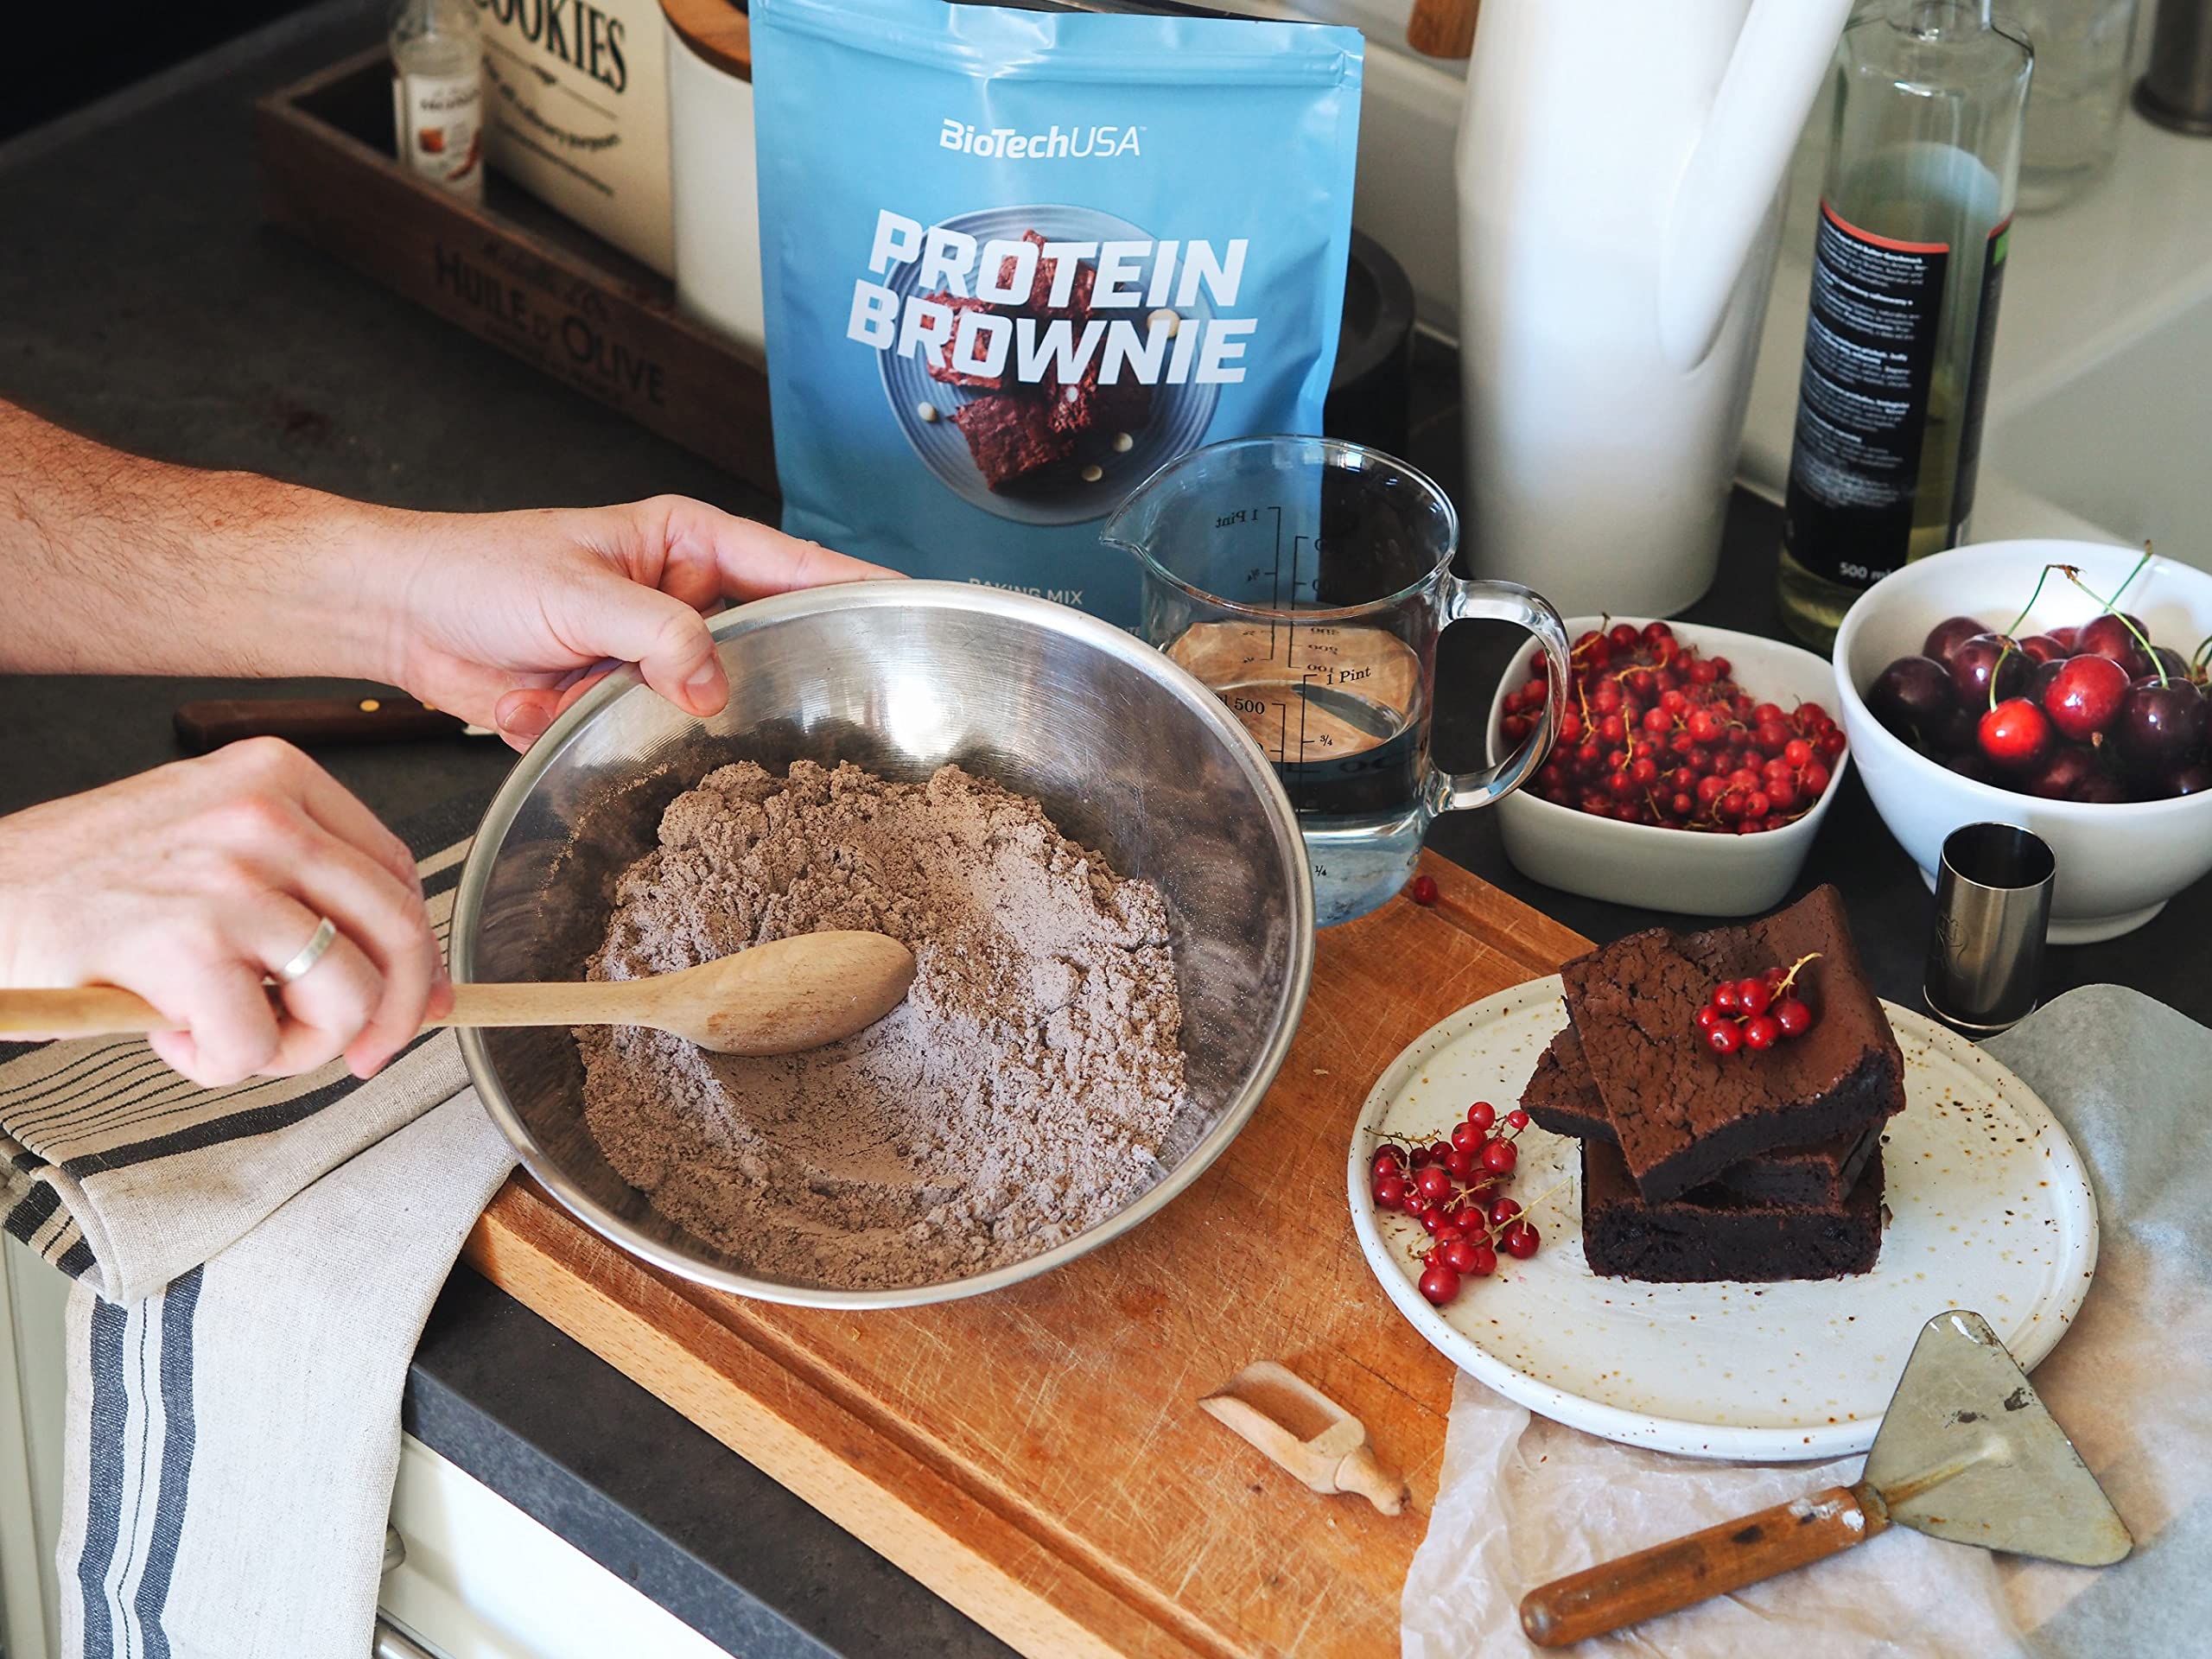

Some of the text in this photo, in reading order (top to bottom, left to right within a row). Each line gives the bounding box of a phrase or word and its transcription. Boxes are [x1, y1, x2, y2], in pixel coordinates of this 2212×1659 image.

[939, 118, 1141, 159] BioTechUSA
[868, 208, 1249, 309] PROTEIN
[846, 278, 1258, 385] BROWNIE
[1839, 562, 1868, 580] 500
[1046, 588, 1083, 605] MIX
[1326, 666, 1371, 685] 1 Pint
[1234, 697, 1265, 715] 500
